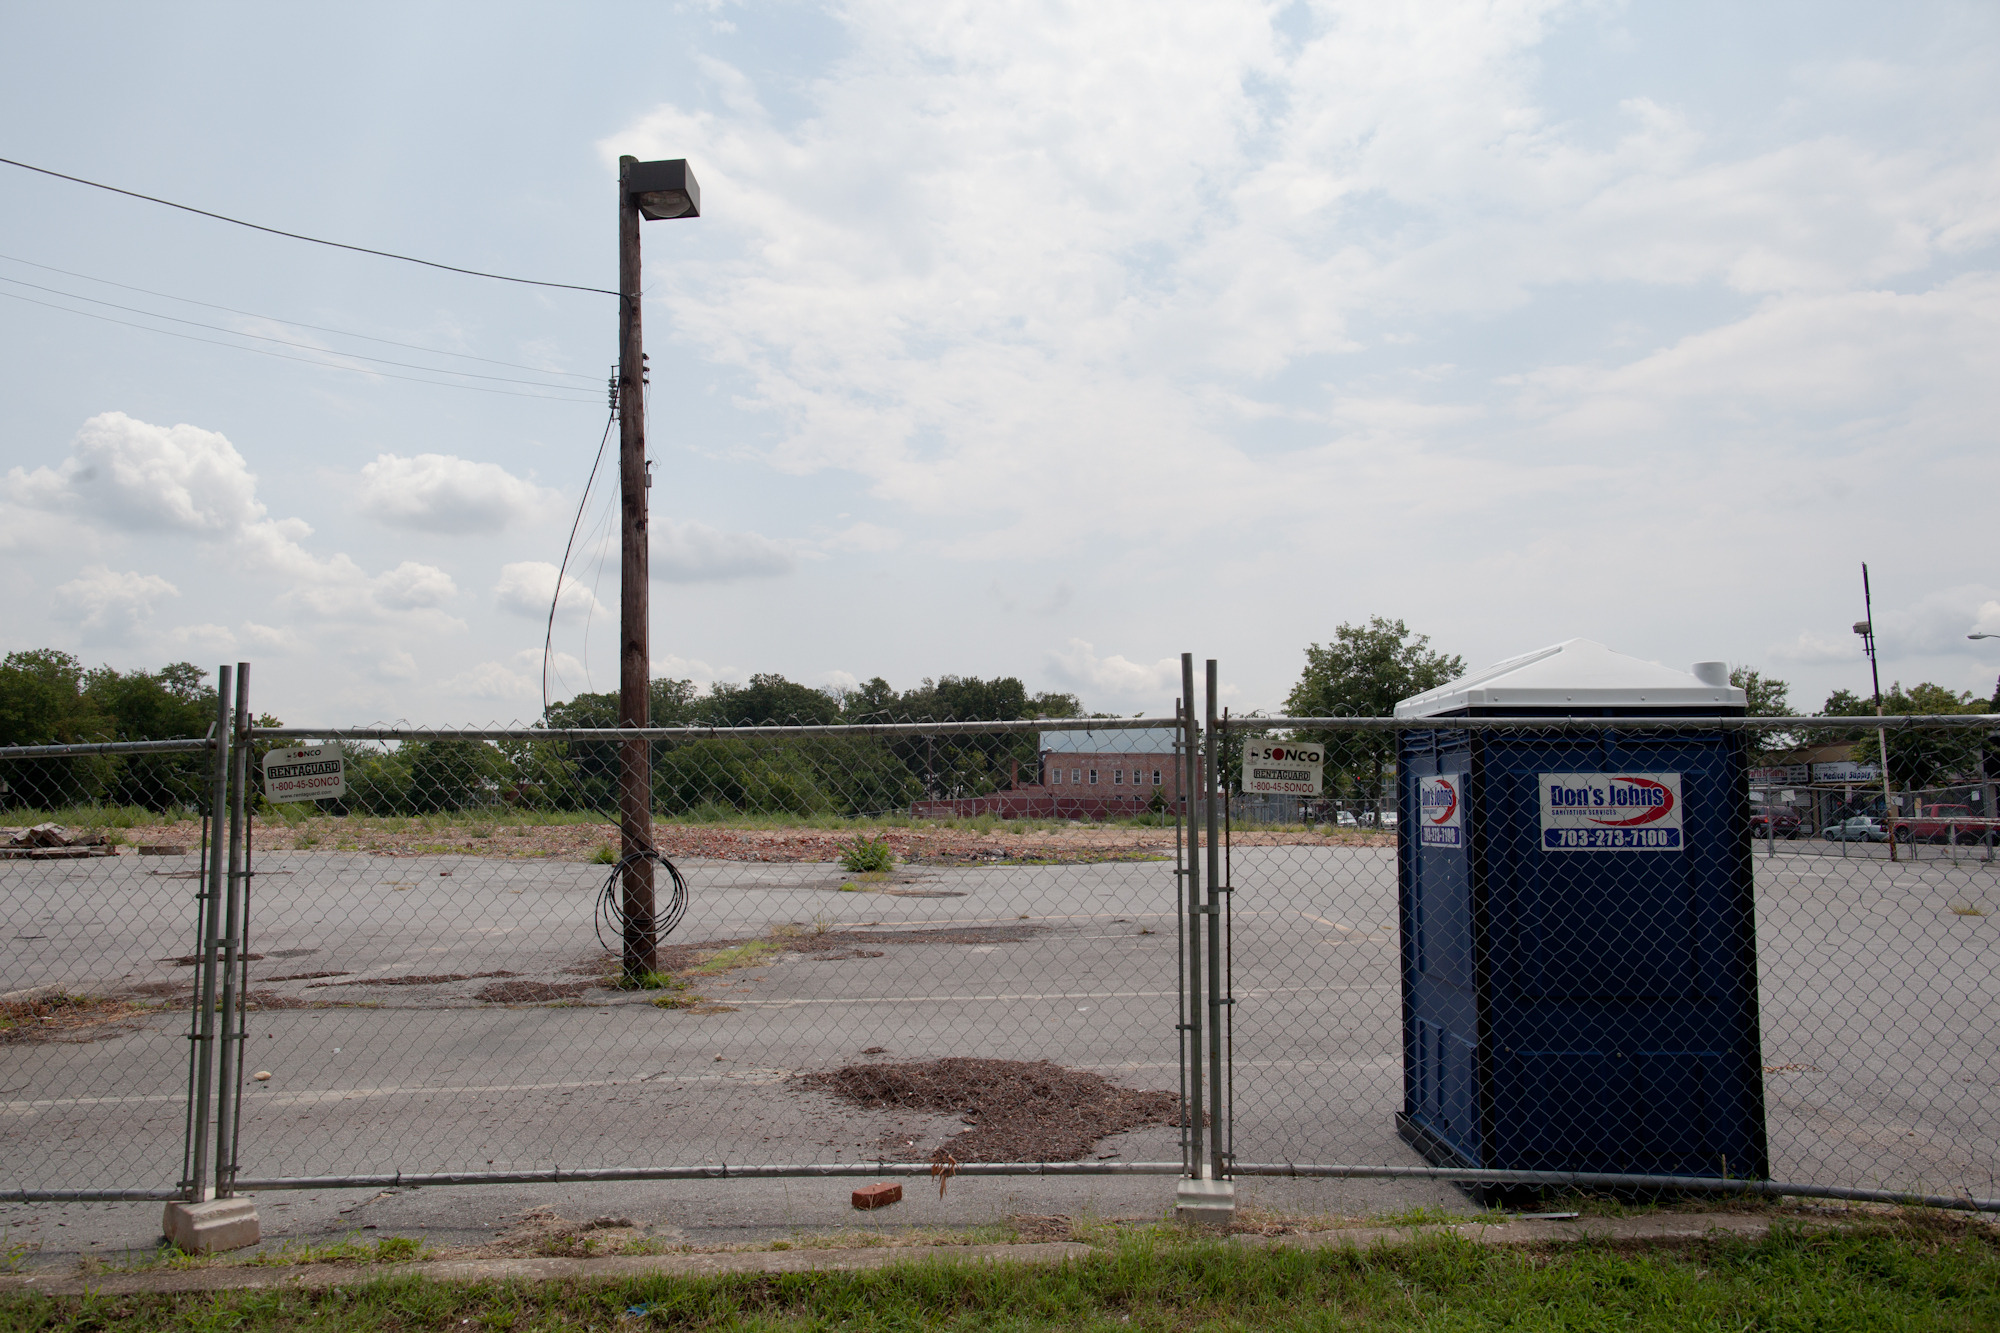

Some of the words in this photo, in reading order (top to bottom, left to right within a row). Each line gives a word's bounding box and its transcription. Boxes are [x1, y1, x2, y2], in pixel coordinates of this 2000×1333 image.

[293, 749, 321, 759] SONCO
[1262, 747, 1320, 762] SONCO
[270, 762, 339, 777] RENTAGUARD
[1254, 770, 1310, 781] RENTAGUARD
[1823, 771, 1846, 781] Medical
[271, 776, 340, 792] 1-800-45-SONCO
[1249, 781, 1314, 793] 1-800-45-SONCO
[280, 790, 333, 799] www.rentaguard.com
[1550, 785, 1604, 806] Don's
[1609, 784, 1664, 806] Johns
[1558, 829, 1668, 846] 703-273-7100
